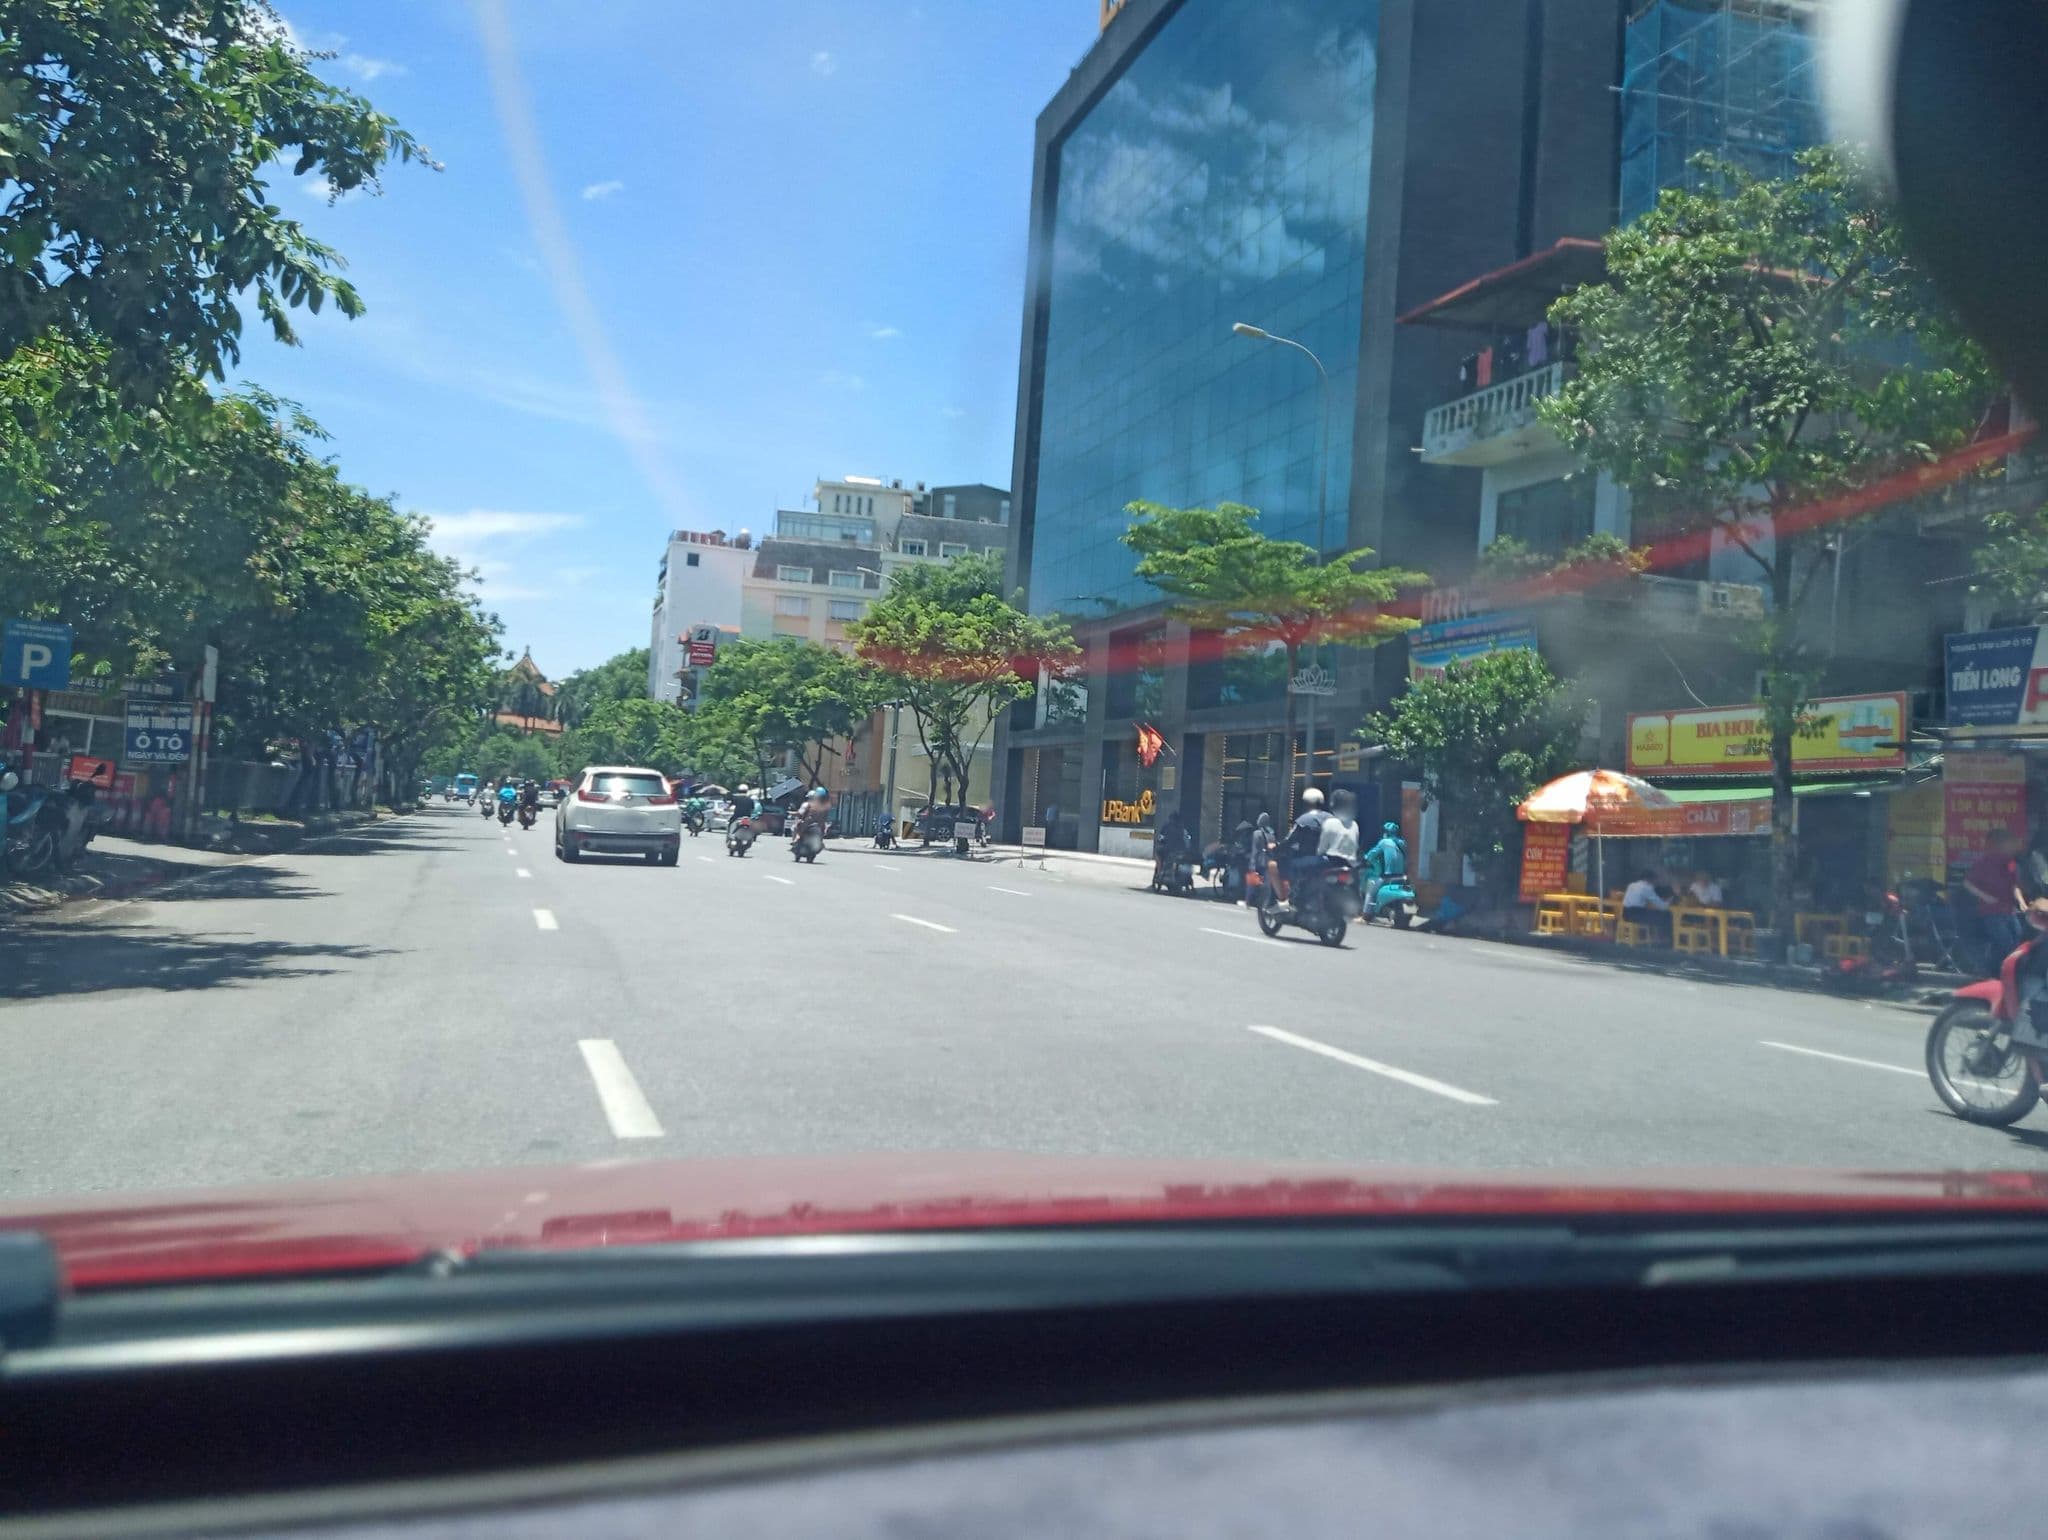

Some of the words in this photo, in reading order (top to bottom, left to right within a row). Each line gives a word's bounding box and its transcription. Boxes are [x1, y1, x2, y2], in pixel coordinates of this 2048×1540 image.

[20, 643, 53, 680] P
[1982, 666, 2021, 689] LONG
[135, 731, 151, 749] Ô
[156, 733, 183, 751] TÔ
[1696, 722, 1721, 738] BIA
[1103, 799, 1141, 824] LPBank
